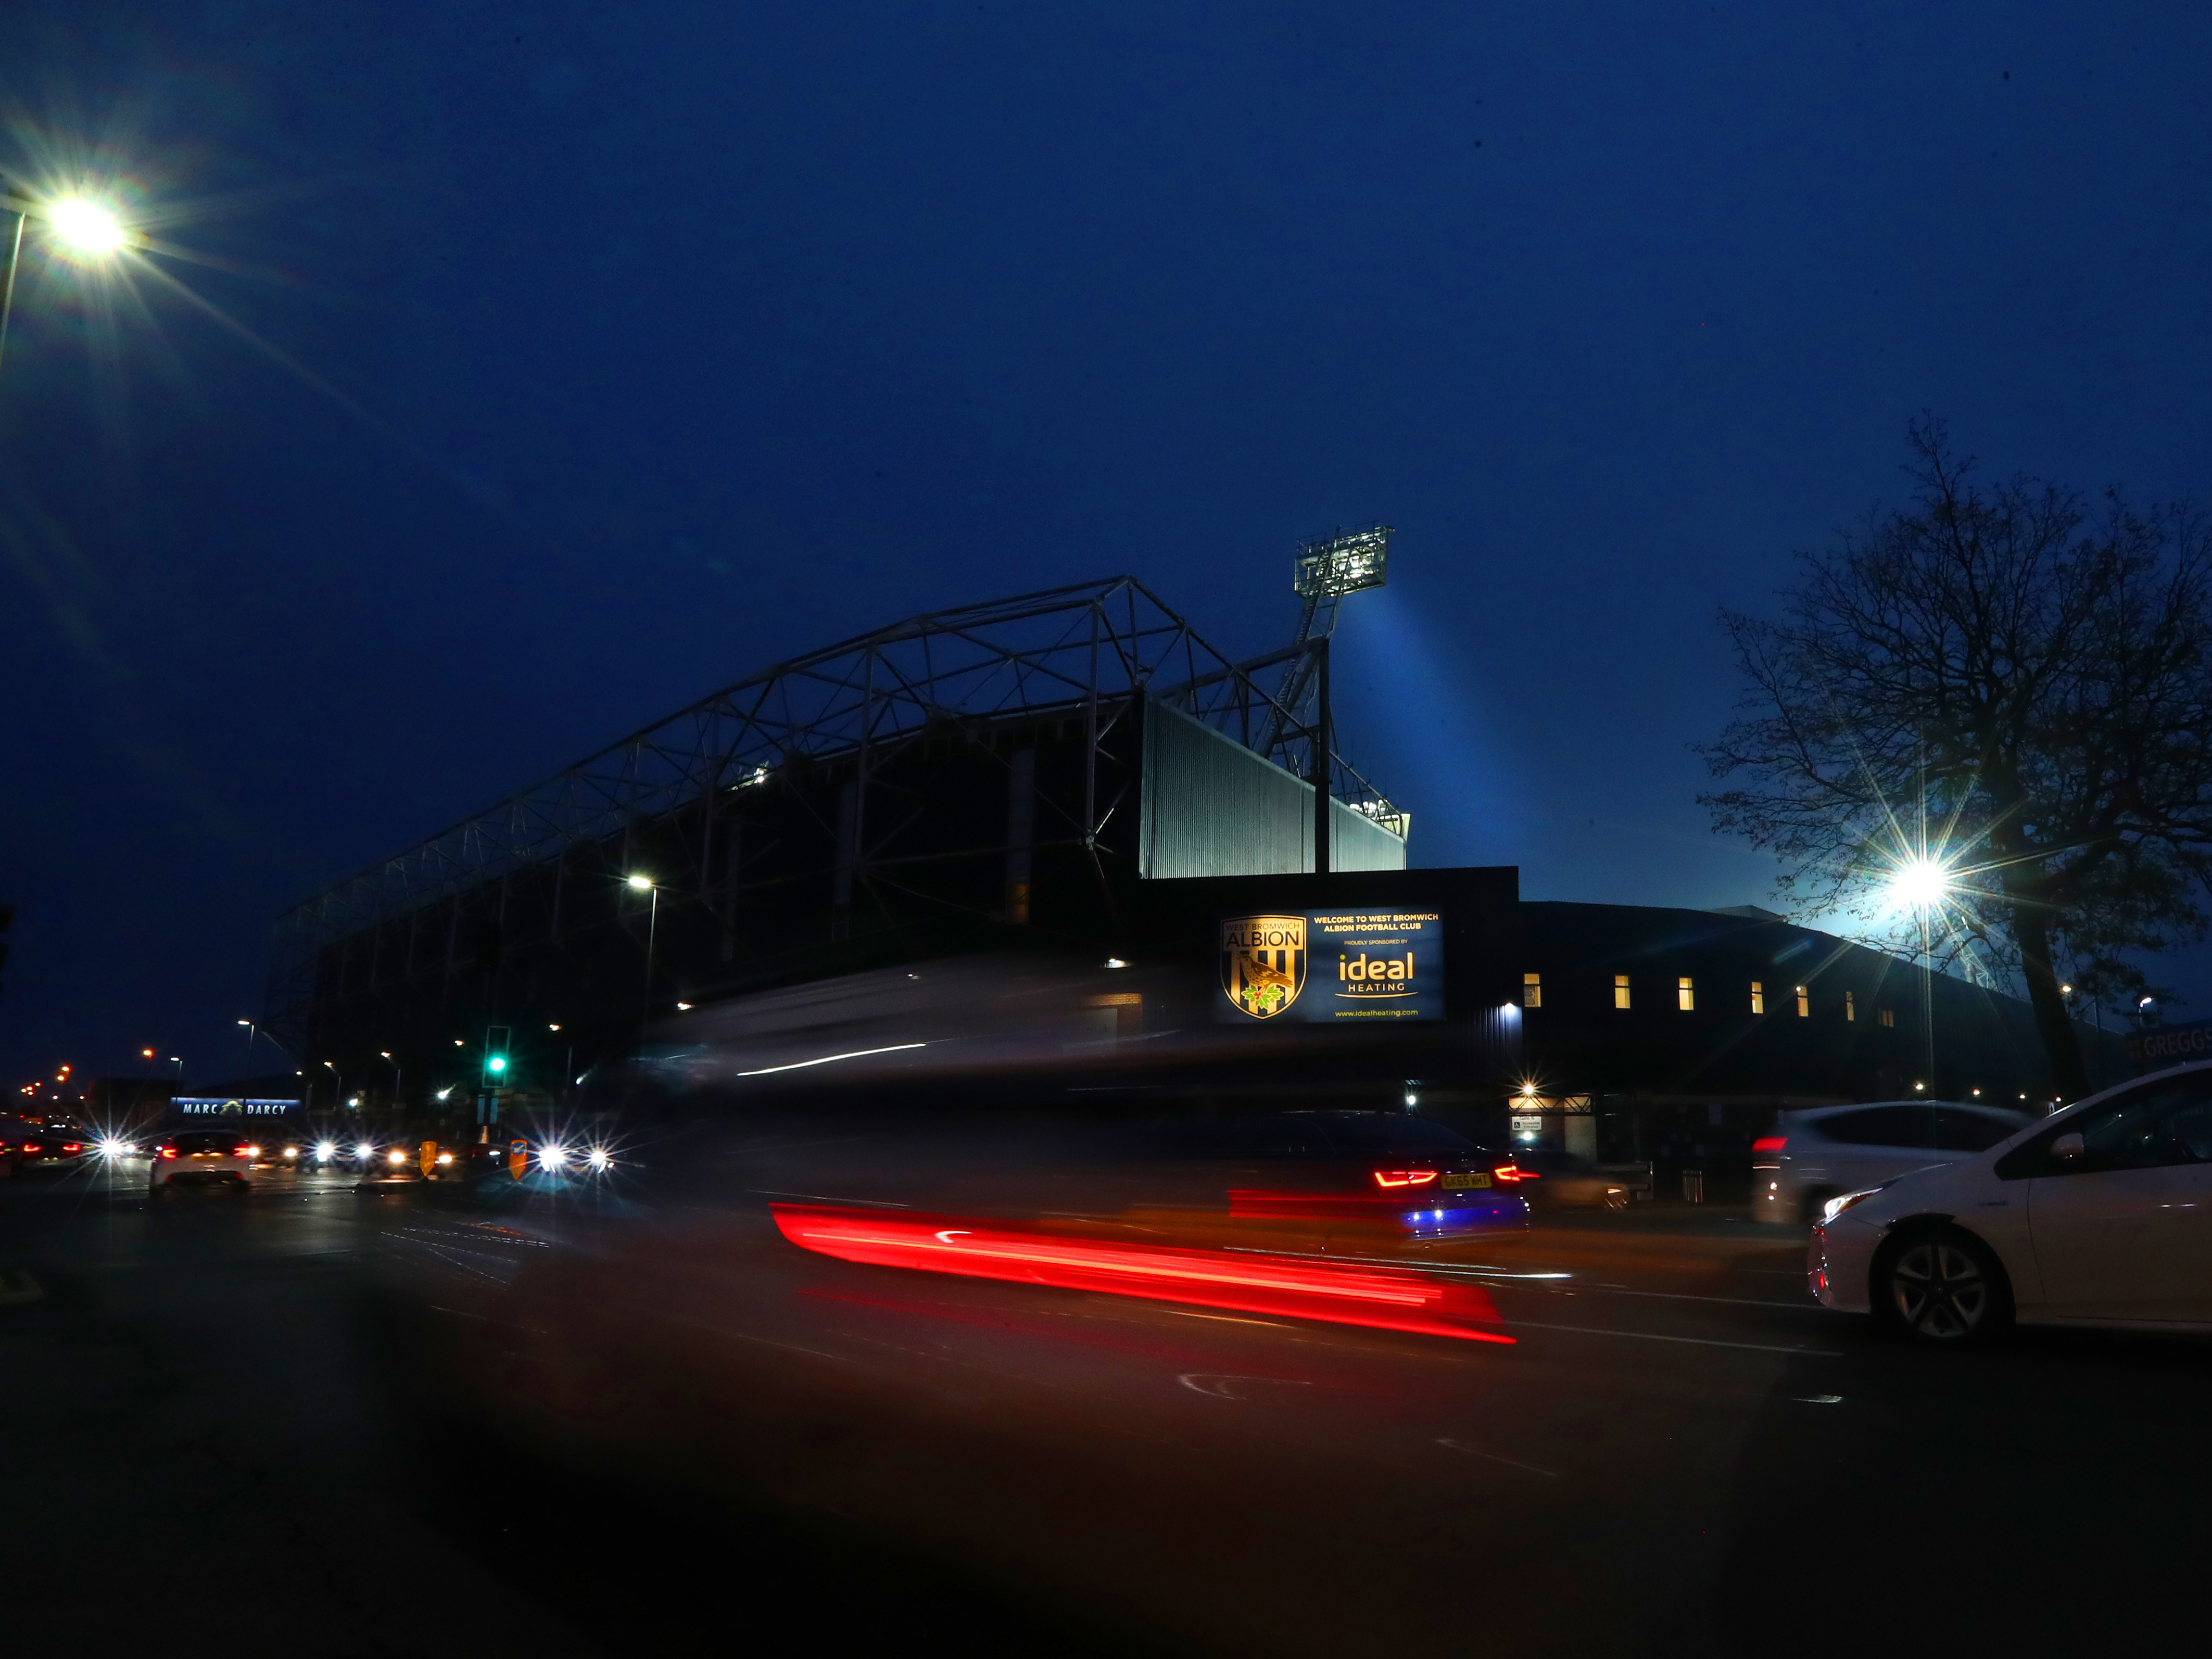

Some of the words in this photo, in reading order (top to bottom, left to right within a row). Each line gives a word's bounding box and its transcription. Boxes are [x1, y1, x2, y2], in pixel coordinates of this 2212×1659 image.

[1226, 931, 1299, 947] ALBION
[1339, 952, 1413, 981] ideal
[1348, 983, 1405, 992] HEATING
[183, 1104, 218, 1114] MARC
[247, 1105, 286, 1115] DARCY
